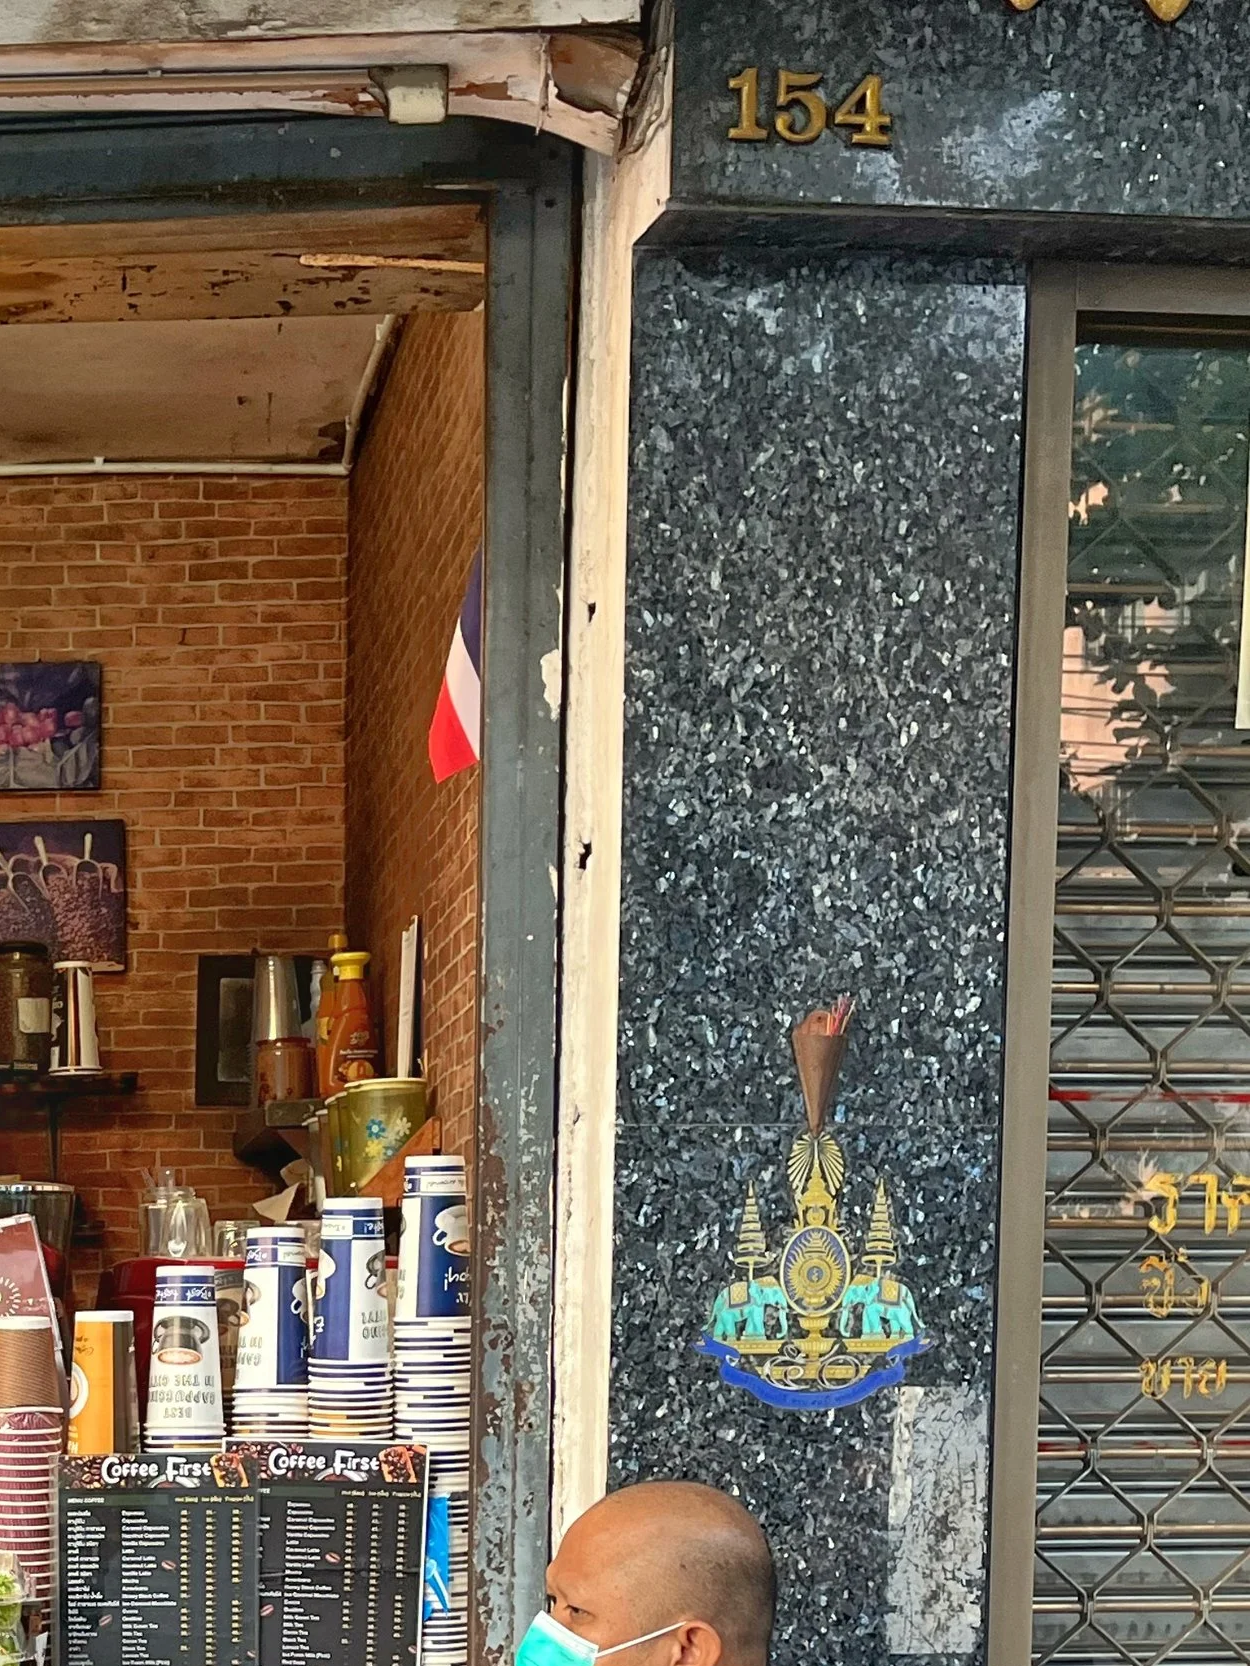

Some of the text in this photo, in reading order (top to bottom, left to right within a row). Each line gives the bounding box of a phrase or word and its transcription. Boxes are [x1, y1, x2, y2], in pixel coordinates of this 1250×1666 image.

[726, 67, 892, 146] 154
[174, 1374, 200, 1387] THE
[1139, 1356, 1229, 1400] ขาย
[163, 1406, 192, 1419] BEST
[101, 1456, 212, 1484] Coffee First
[268, 1448, 379, 1476] Coffee First
